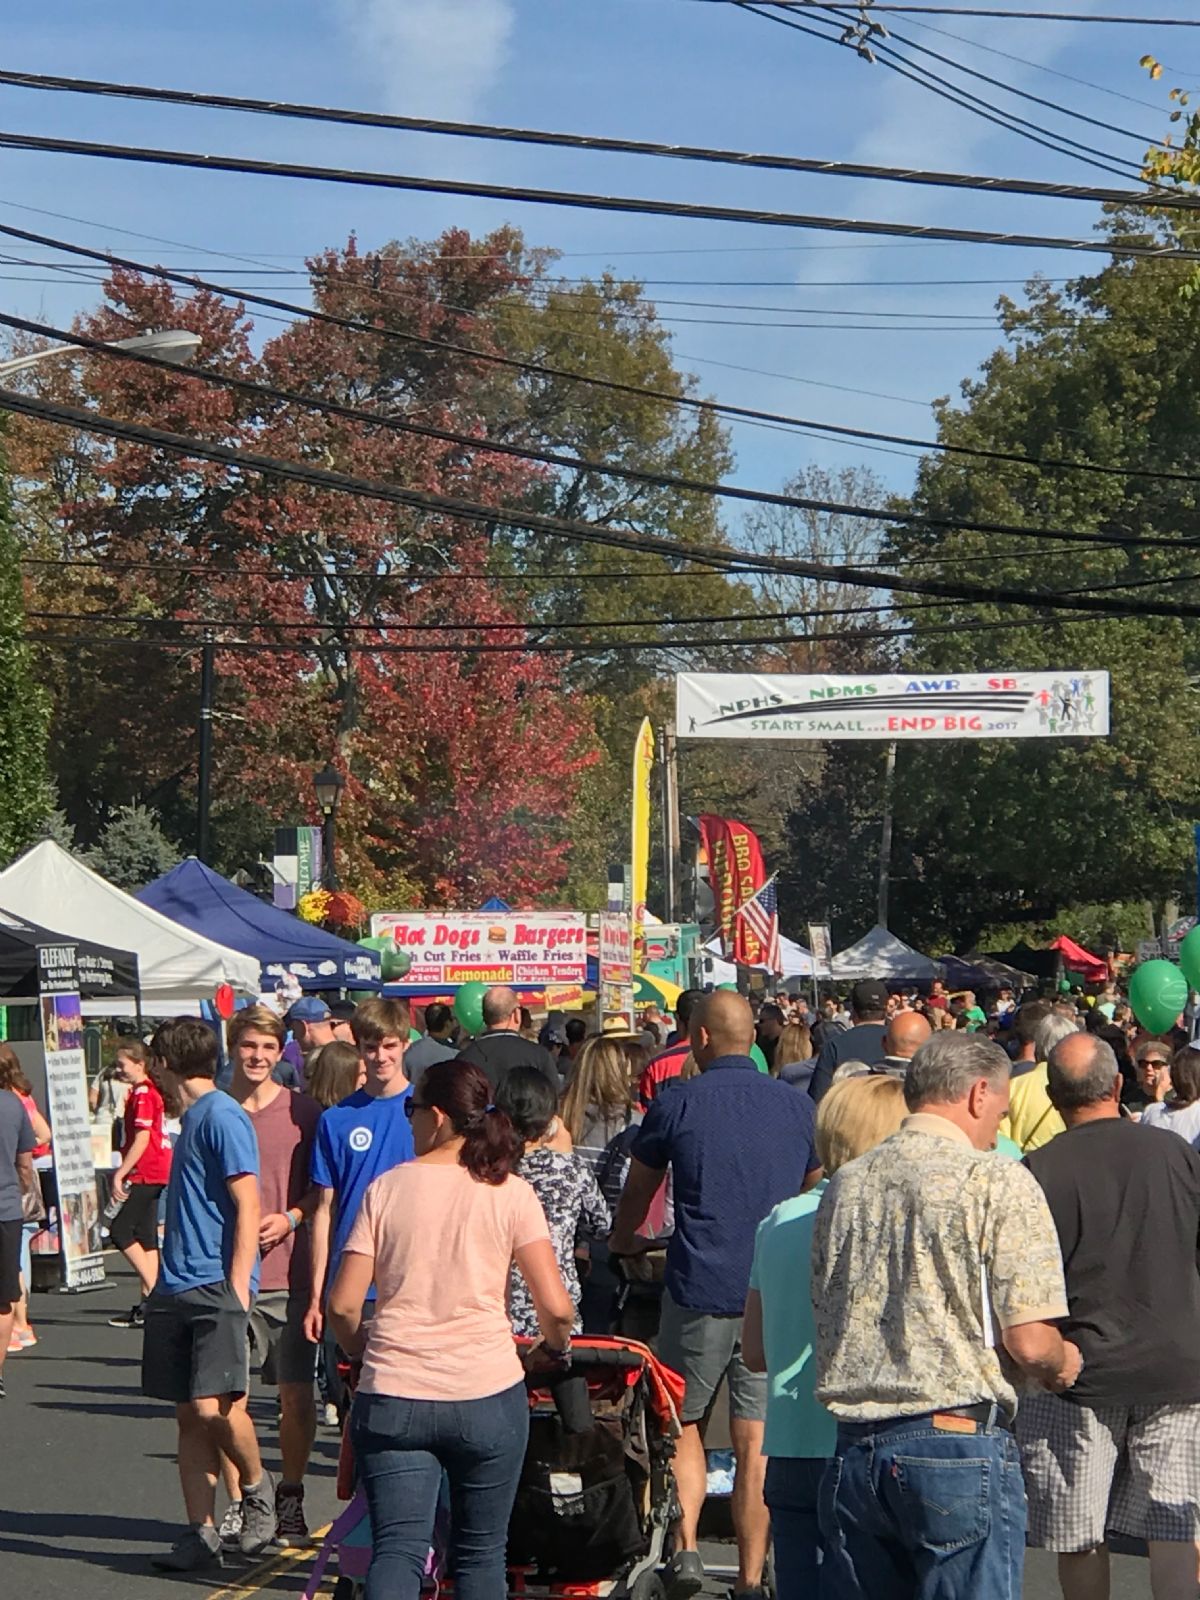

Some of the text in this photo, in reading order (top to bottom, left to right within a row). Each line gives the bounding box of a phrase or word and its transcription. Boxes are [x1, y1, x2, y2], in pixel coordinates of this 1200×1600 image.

[719, 678, 1018, 716] NPHS NPMS AWR SB
[751, 719, 803, 732] START
[943, 715, 983, 731] BIG
[987, 722, 1018, 731] 2017
[394, 924, 480, 950] Hot Dogs
[513, 924, 585, 949] Burgers
[40, 947, 77, 969] ELEFANTE
[423, 950, 446, 962] Cut
[451, 950, 481, 962] Fries
[497, 949, 574, 961] Waffle Fries
[445, 967, 513, 982] Lemonade
[517, 966, 583, 976] Chicken Tenders
